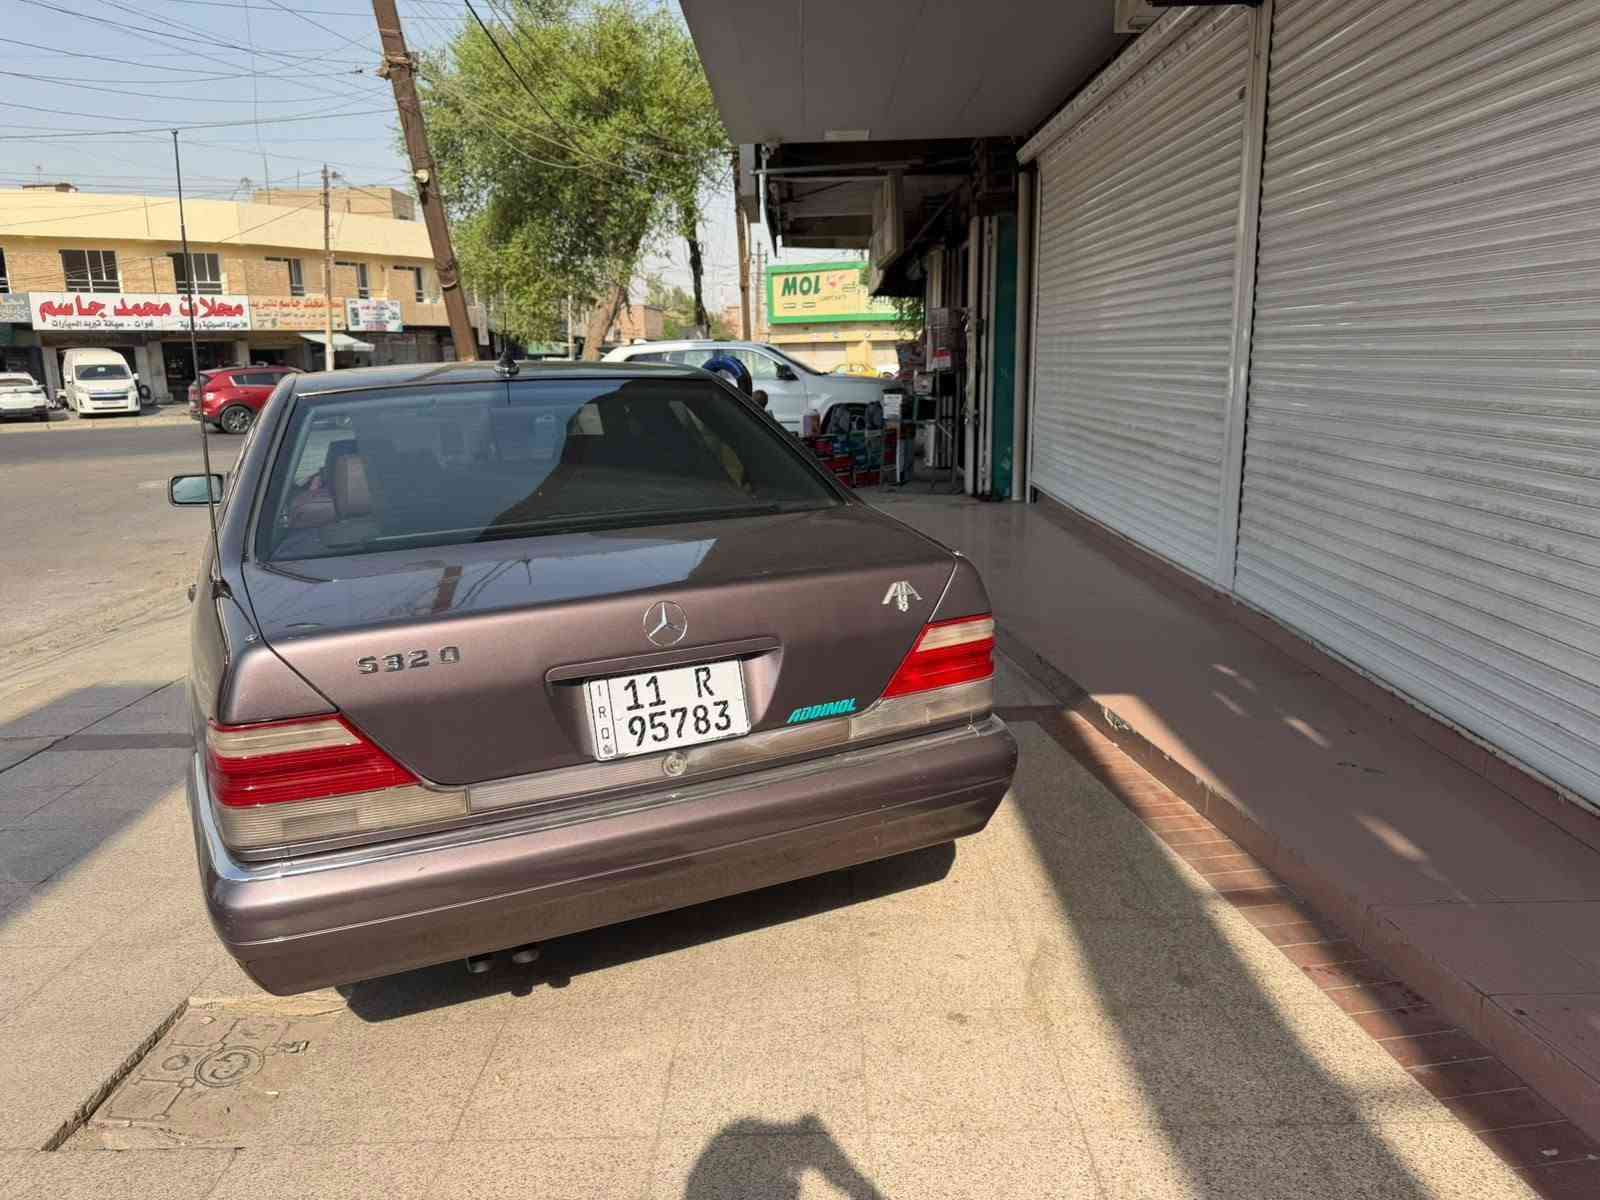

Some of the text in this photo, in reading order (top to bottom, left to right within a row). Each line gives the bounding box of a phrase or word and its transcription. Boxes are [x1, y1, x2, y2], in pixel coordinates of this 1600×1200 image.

[781, 275, 821, 296] MOL
[39, 295, 107, 322] جاسم
[113, 298, 171, 317] محمد
[179, 296, 244, 318] محلات
[51, 319, 82, 329] السيارات
[357, 646, 460, 674] S320
[624, 666, 715, 711] 11 R
[628, 700, 732, 747] 95783
[786, 697, 856, 724] ADDINOL
